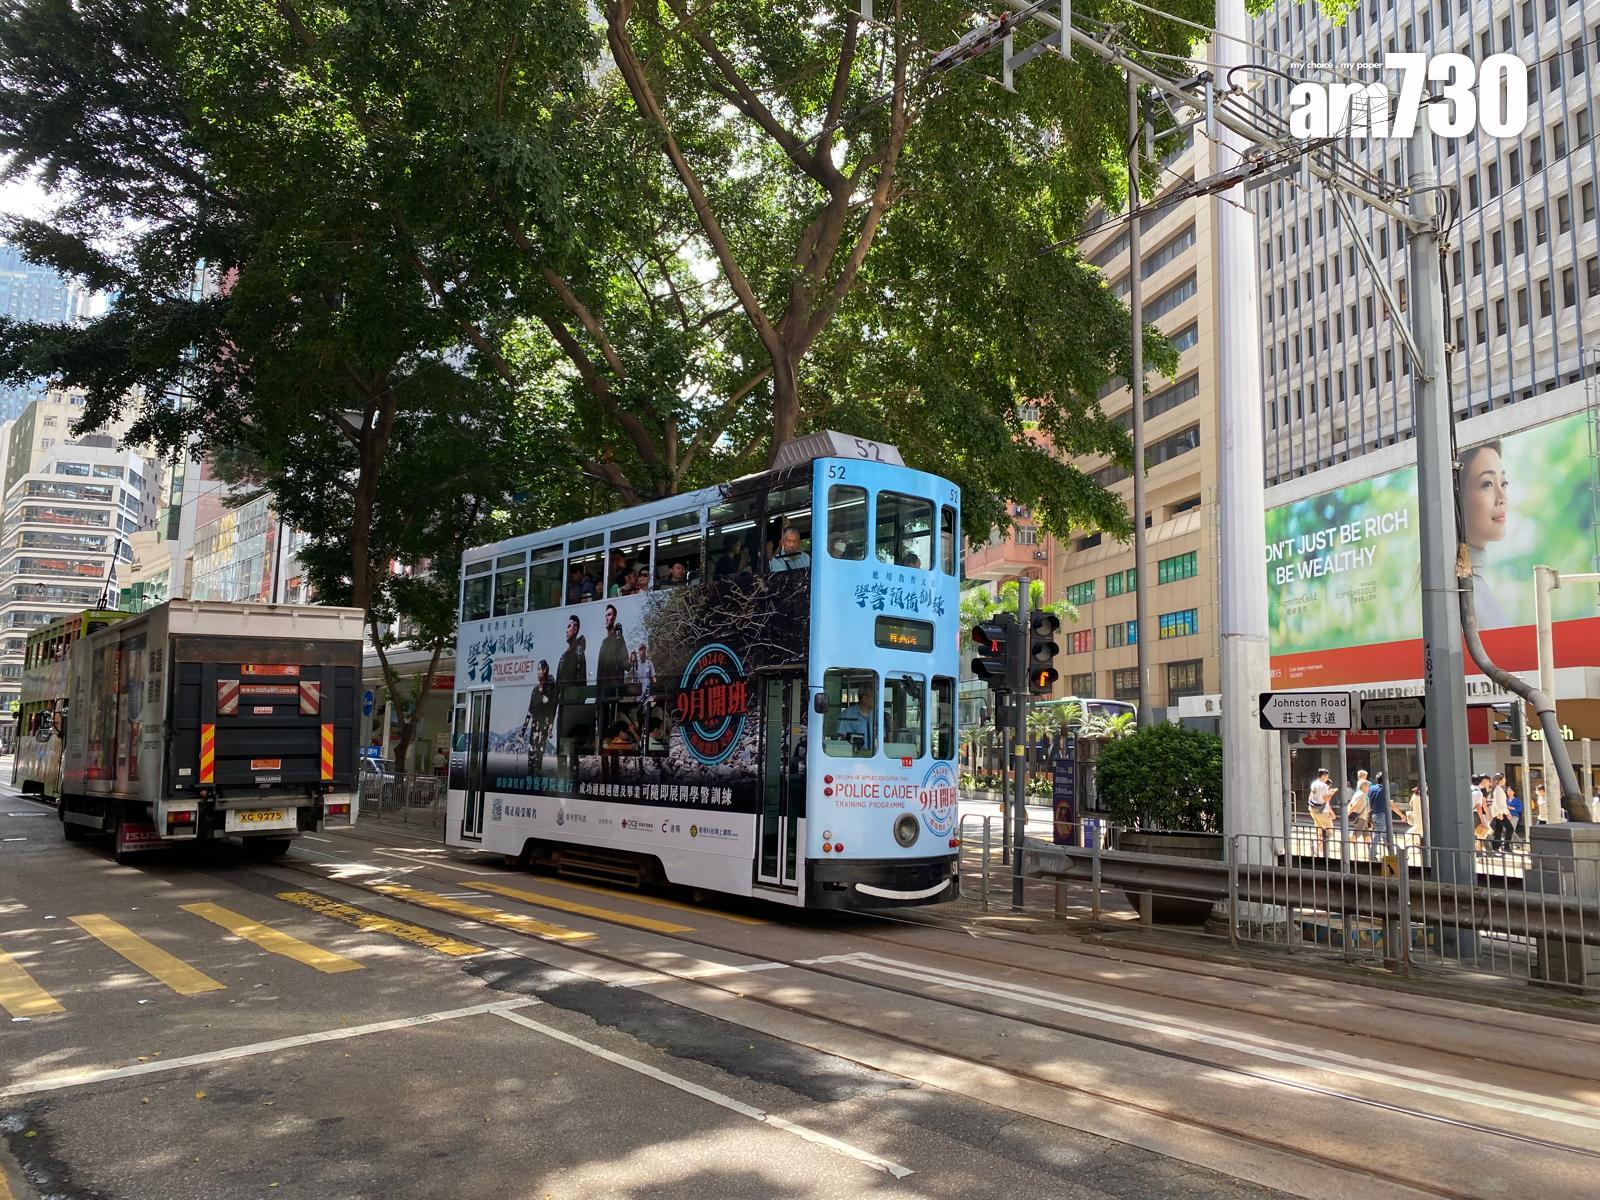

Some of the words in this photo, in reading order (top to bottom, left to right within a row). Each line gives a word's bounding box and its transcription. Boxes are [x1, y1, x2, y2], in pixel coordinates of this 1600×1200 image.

[855, 439, 885, 463] 52
[828, 465, 846, 480] 52
[1265, 538, 1296, 563] ON'T
[1297, 527, 1337, 555] JUST
[1339, 521, 1362, 544] BE
[1365, 508, 1409, 539] RICH
[1276, 564, 1295, 586] BE
[1296, 545, 1377, 580] WEALTHY
[677, 680, 748, 722] 9月開班
[1273, 698, 1317, 708] Johnston
[1320, 698, 1347, 707] Road
[1399, 701, 1416, 709] Road
[1282, 712, 1337, 725] 莊士敦道
[835, 783, 880, 799] POLICE
[883, 785, 919, 799] CADET
[836, 800, 867, 809] TRAINING
[868, 801, 905, 809] PROGRAMME
[241, 813, 254, 821] XG
[257, 812, 282, 820] 9275
[125, 832, 159, 841] ISUZ
